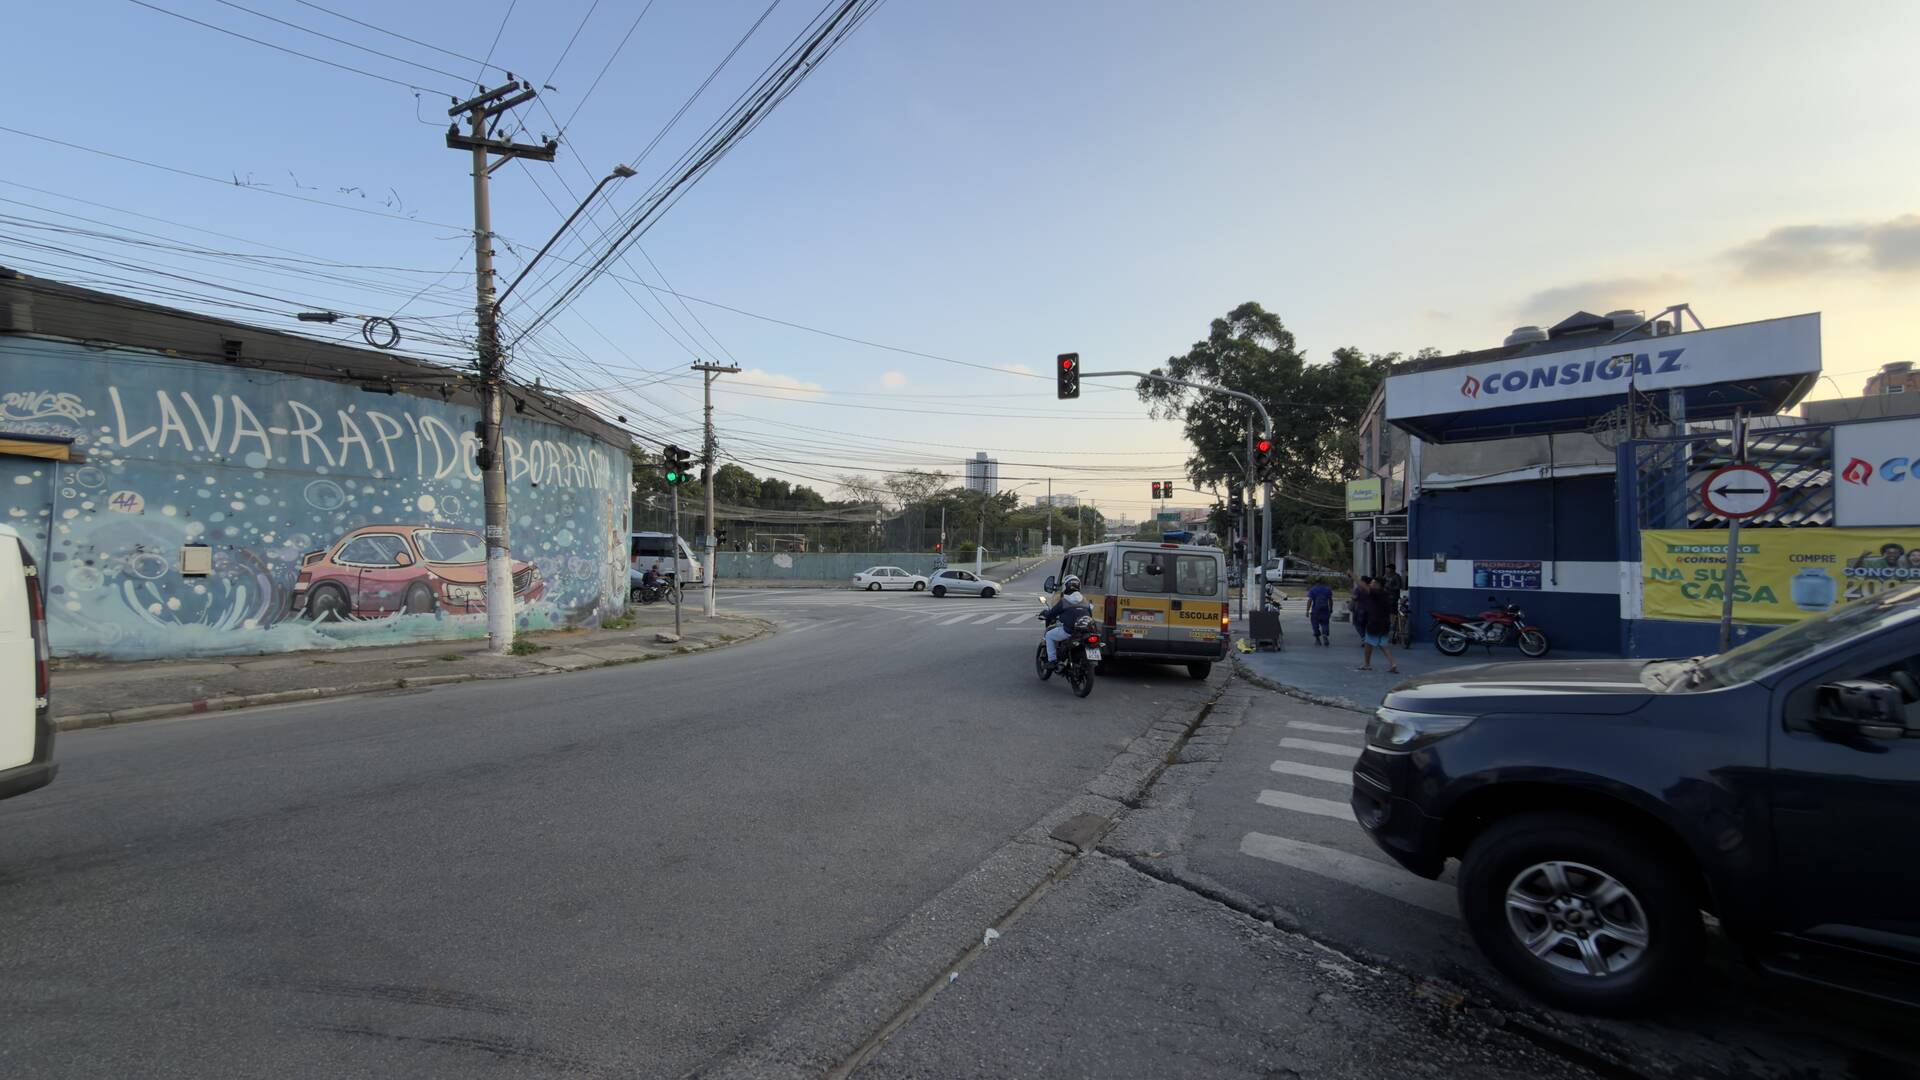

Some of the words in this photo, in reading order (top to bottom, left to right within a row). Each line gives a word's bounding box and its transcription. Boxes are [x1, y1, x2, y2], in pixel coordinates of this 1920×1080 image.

[1483, 348, 1685, 394] CONSIGAZ
[1684, 556, 1744, 564] CONSIGZ
[1789, 553, 1837, 563] COMPRE
[1650, 567, 1684, 580] NA
[1694, 568, 1748, 582] SUA
[1681, 582, 1779, 604] CASA
[1179, 610, 1219, 621] ESCOLAR
